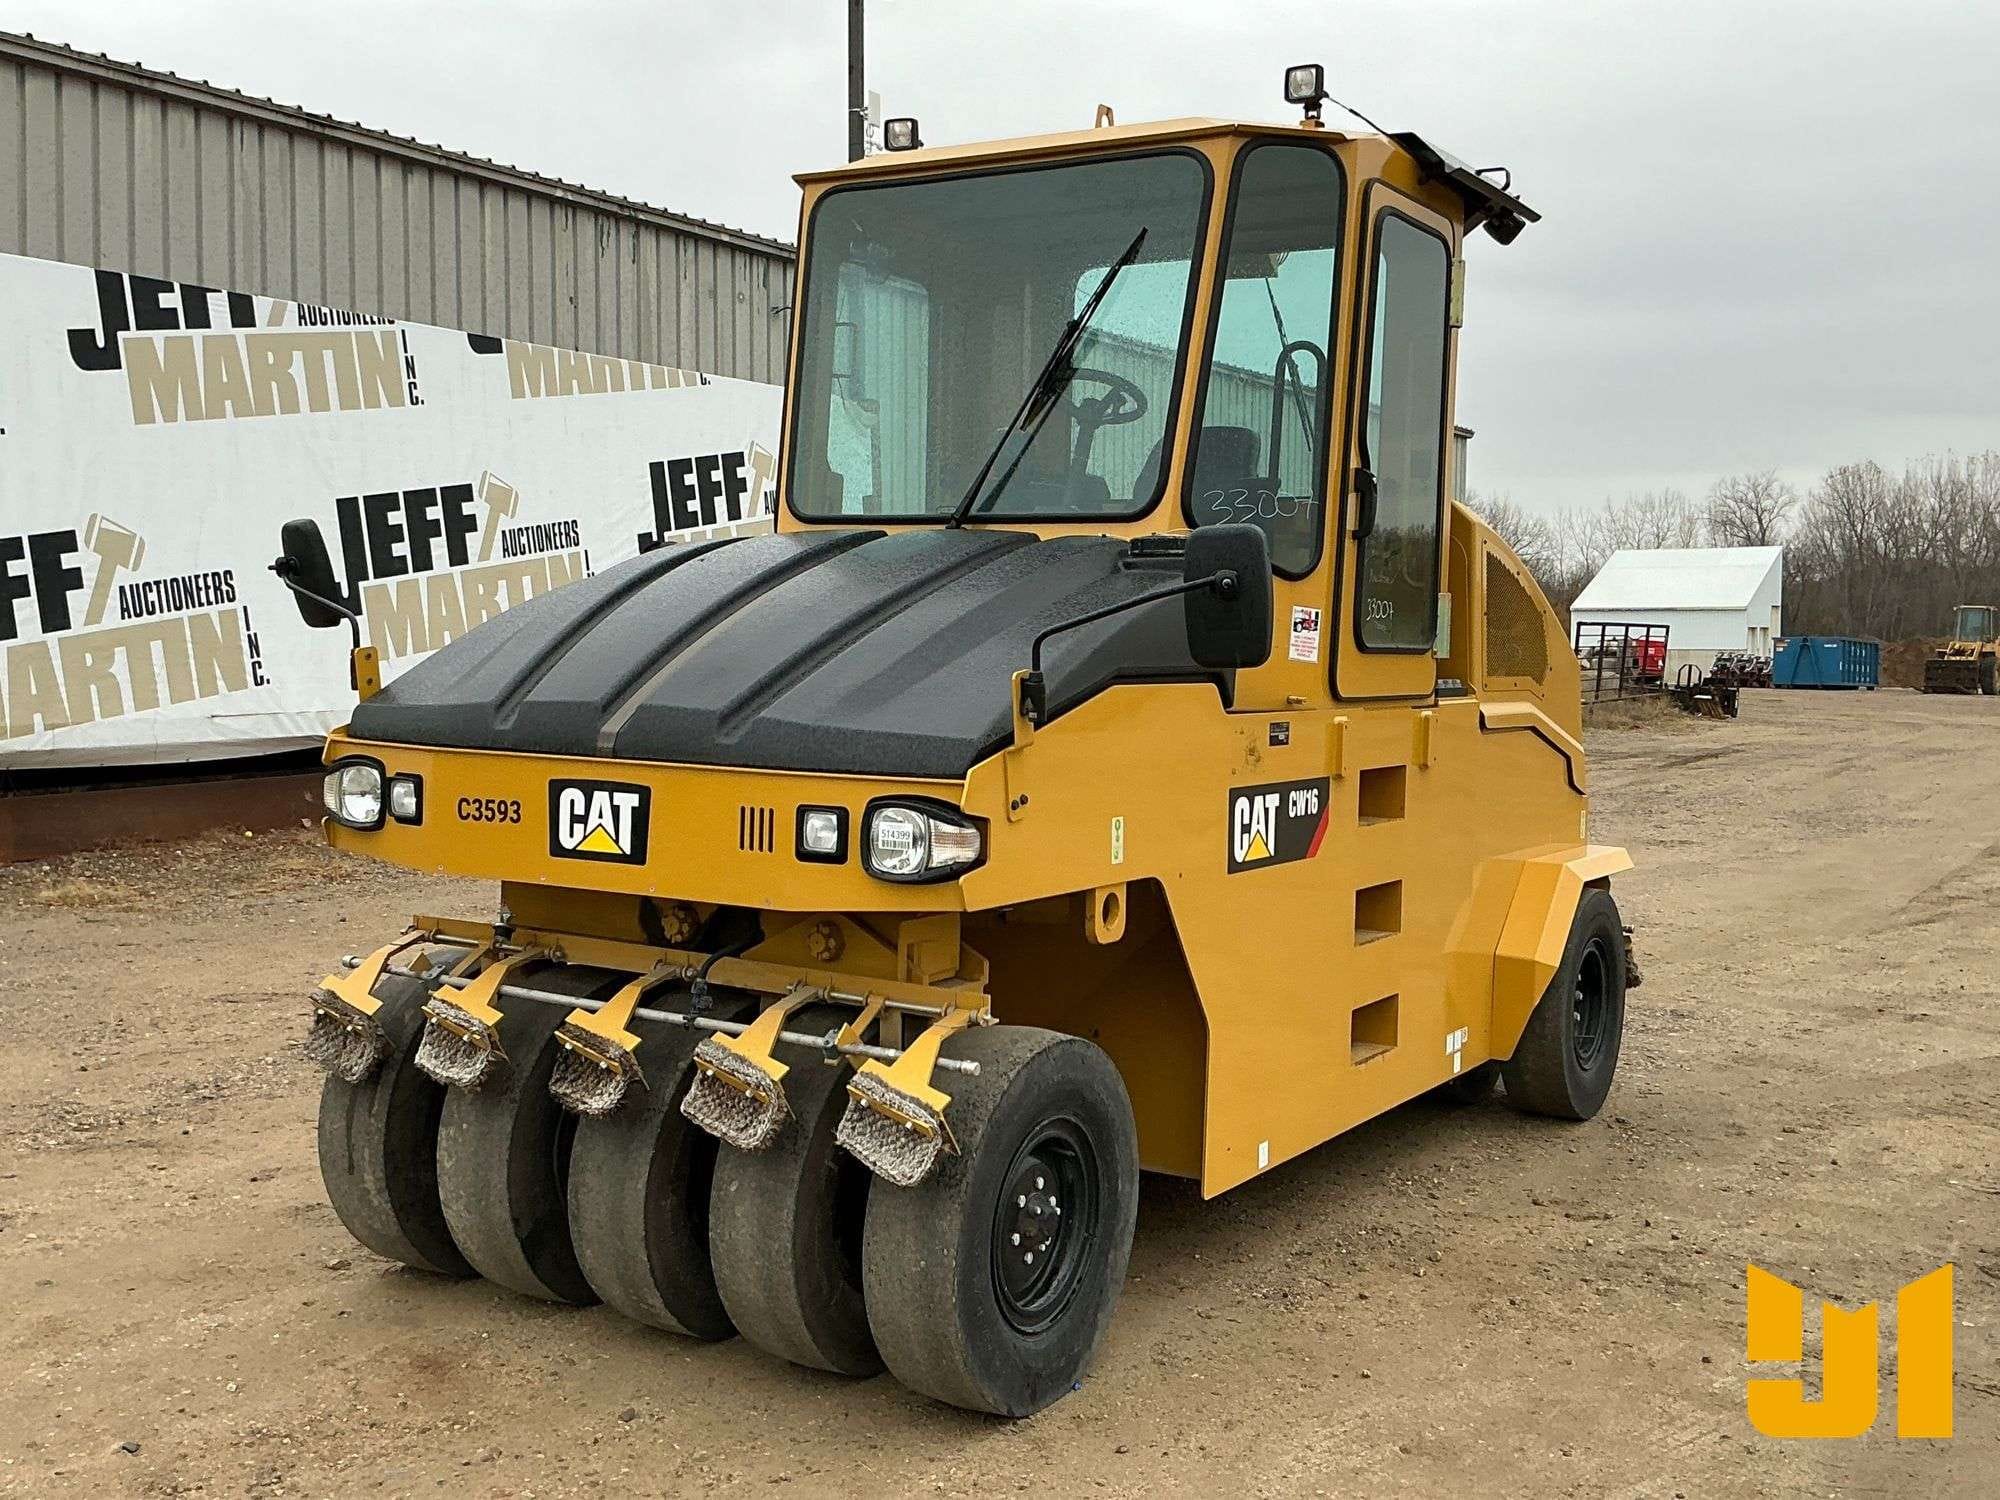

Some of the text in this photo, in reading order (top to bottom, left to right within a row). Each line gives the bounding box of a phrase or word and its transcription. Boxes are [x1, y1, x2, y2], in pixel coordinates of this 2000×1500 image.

[123, 331, 405, 425] MARTIN
[502, 519, 580, 558] AUCTIONEERS
[119, 569, 236, 620] AUCTIONEERS
[457, 797, 522, 824] C3593
[558, 787, 640, 855] CAT
[1234, 793, 1280, 863] CAT
[1288, 788, 1319, 818] CW16
